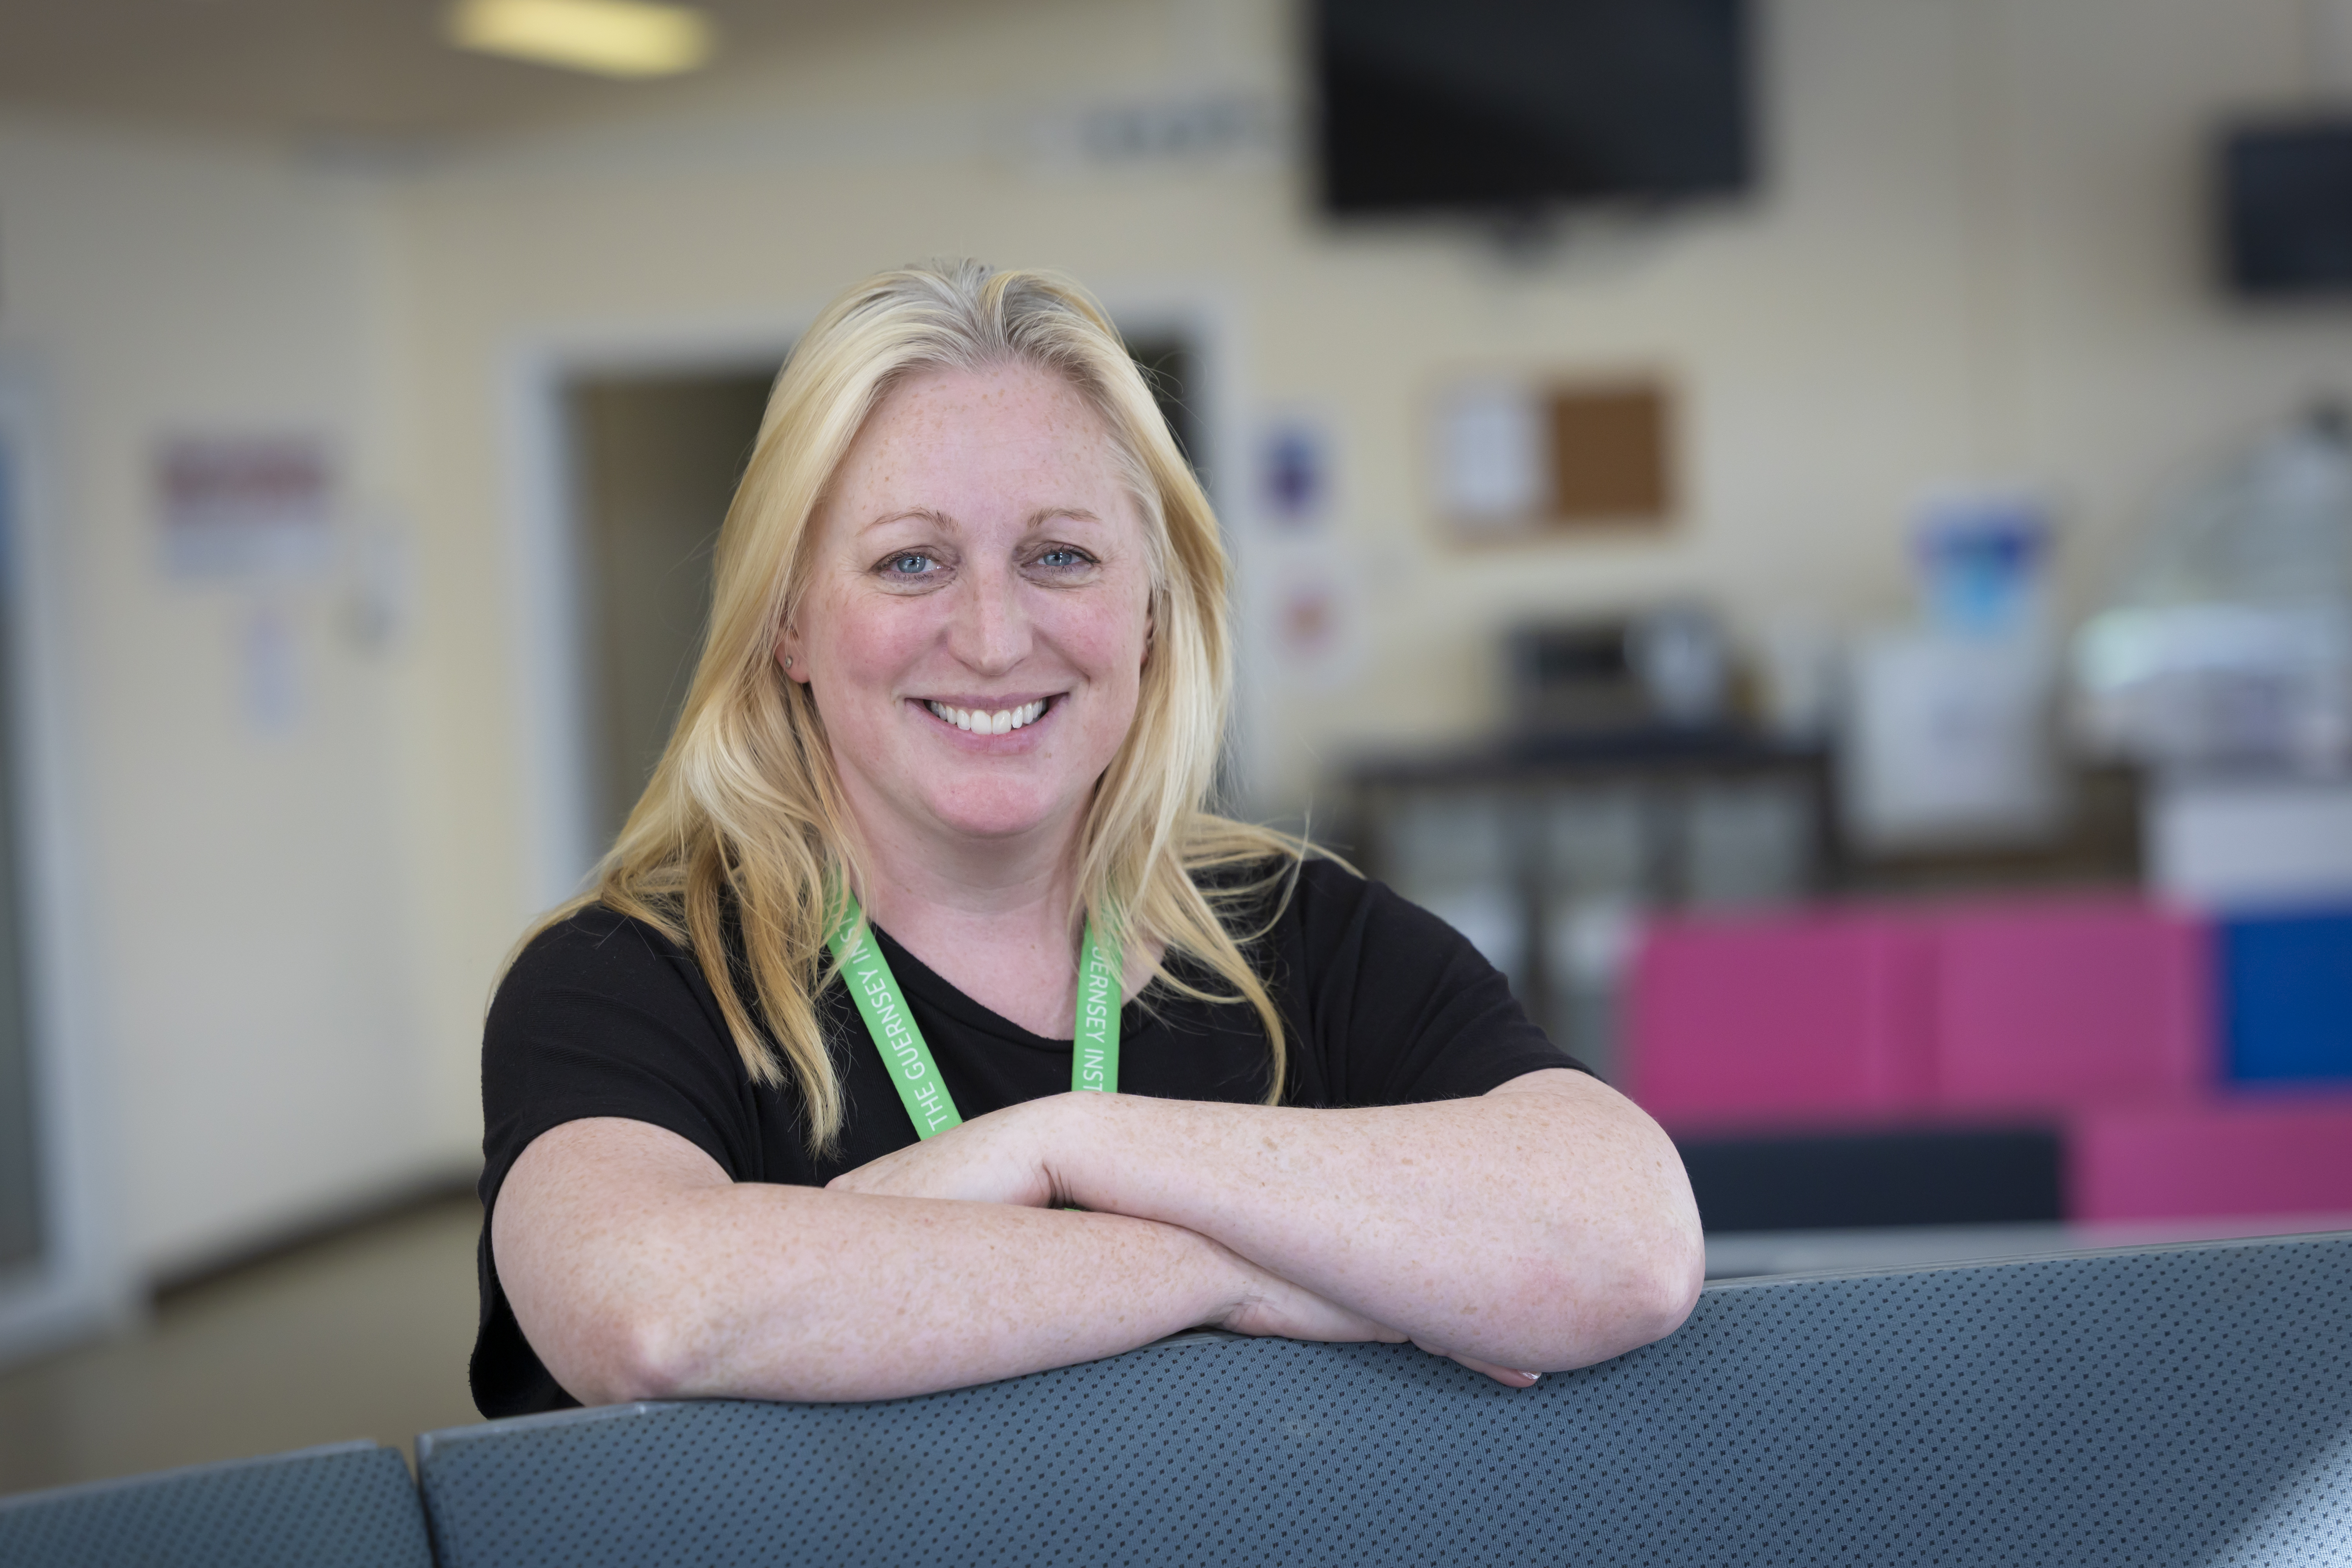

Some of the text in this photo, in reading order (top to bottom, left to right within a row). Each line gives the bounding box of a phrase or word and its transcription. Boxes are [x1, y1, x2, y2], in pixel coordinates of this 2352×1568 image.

[857, 969, 926, 1080] GUERNSEY
[1085, 936, 1110, 1044] UERNSEY
[914, 1082, 947, 1132] THE
